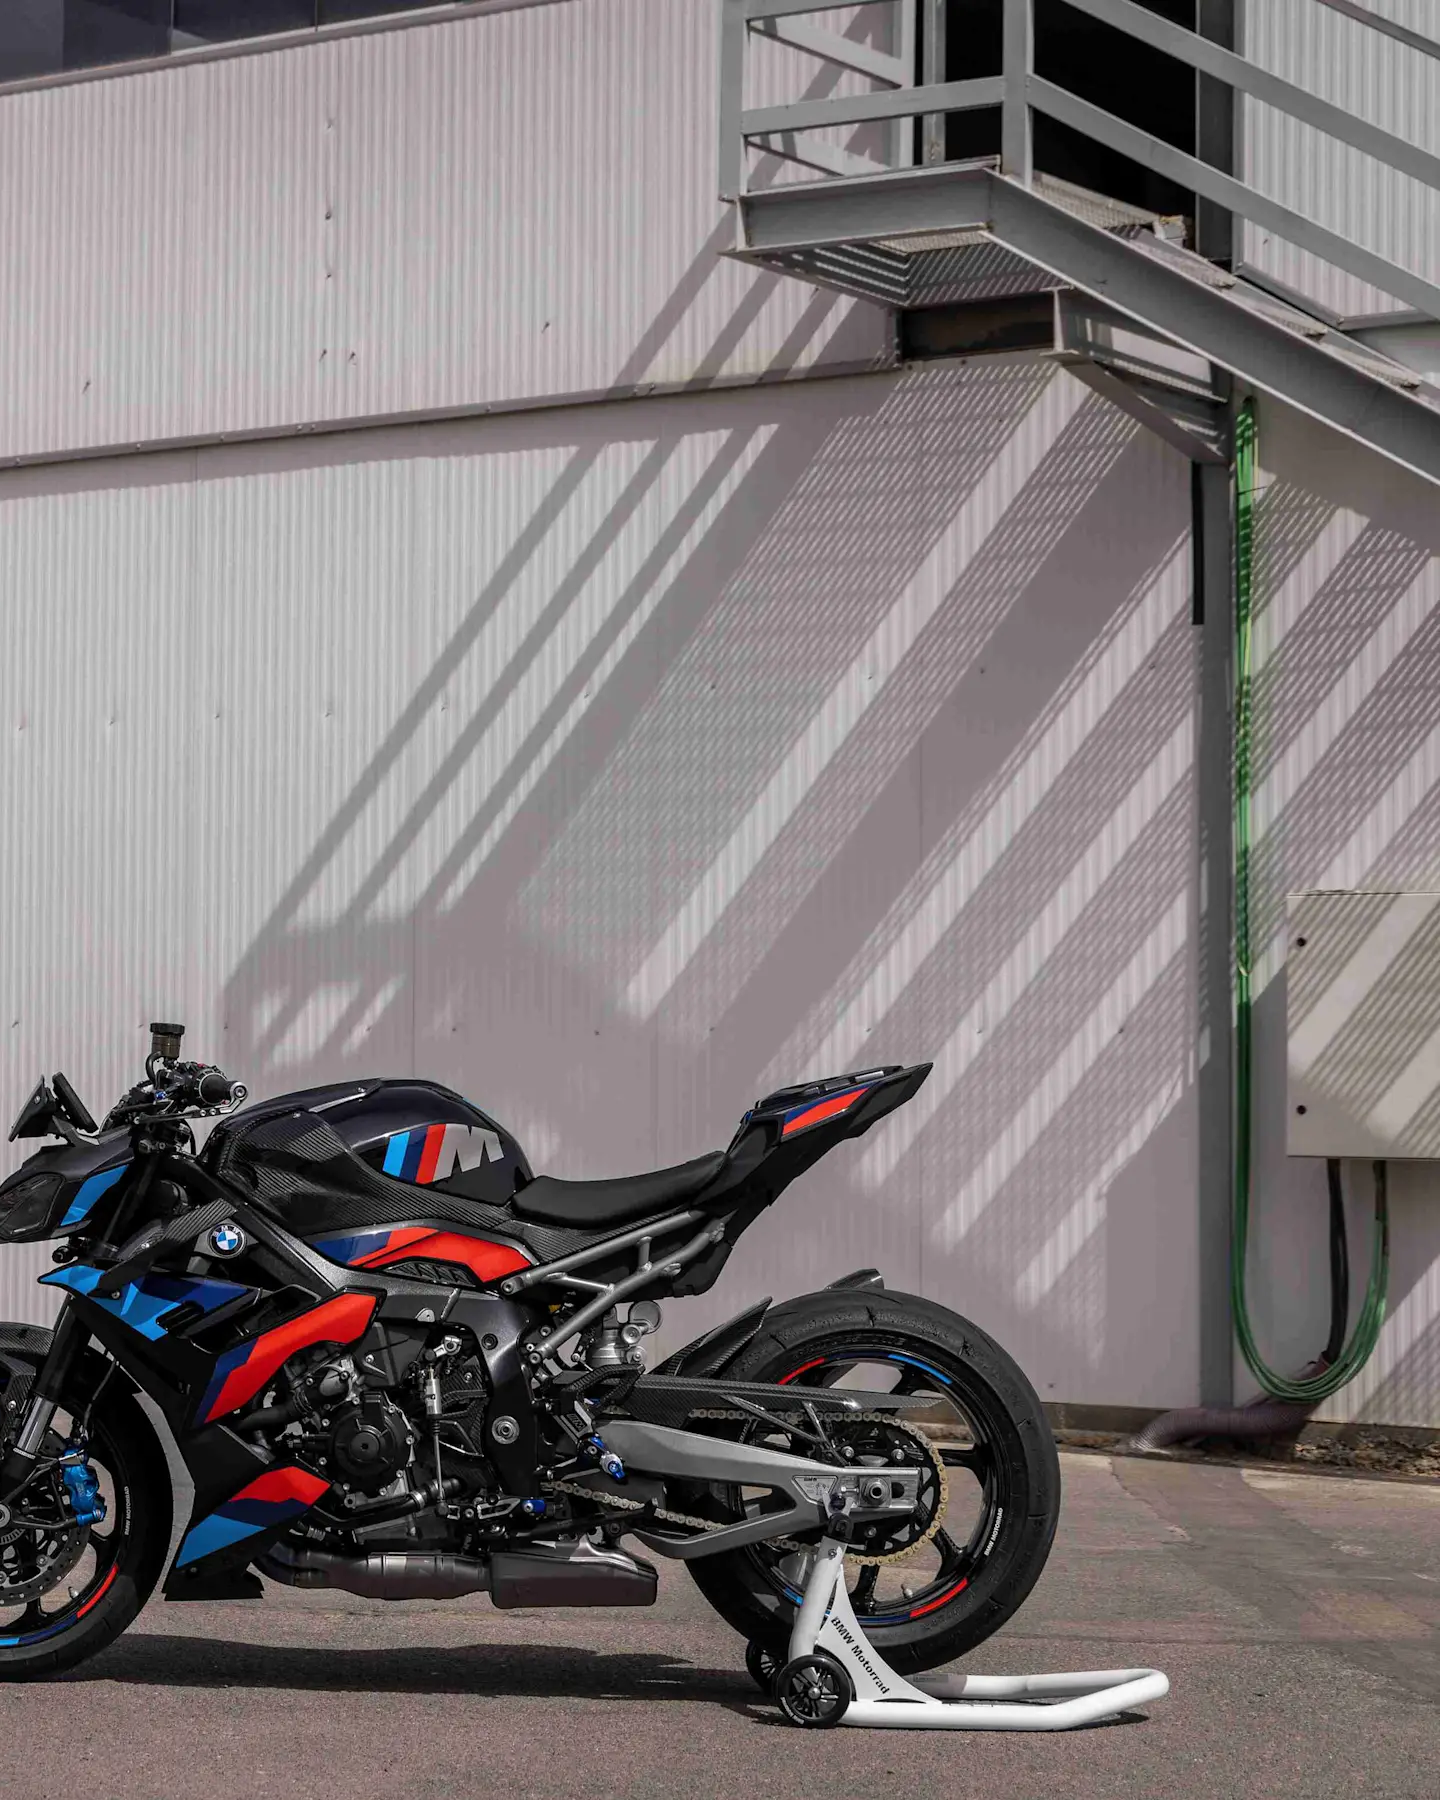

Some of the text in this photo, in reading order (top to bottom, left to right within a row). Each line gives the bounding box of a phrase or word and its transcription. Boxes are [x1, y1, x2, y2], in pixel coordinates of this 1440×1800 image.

[212, 1225, 241, 1237] BMW
[983, 1507, 1003, 1556] BMW MOTORRAD
[831, 1616, 890, 1695] BMW Motorrad
